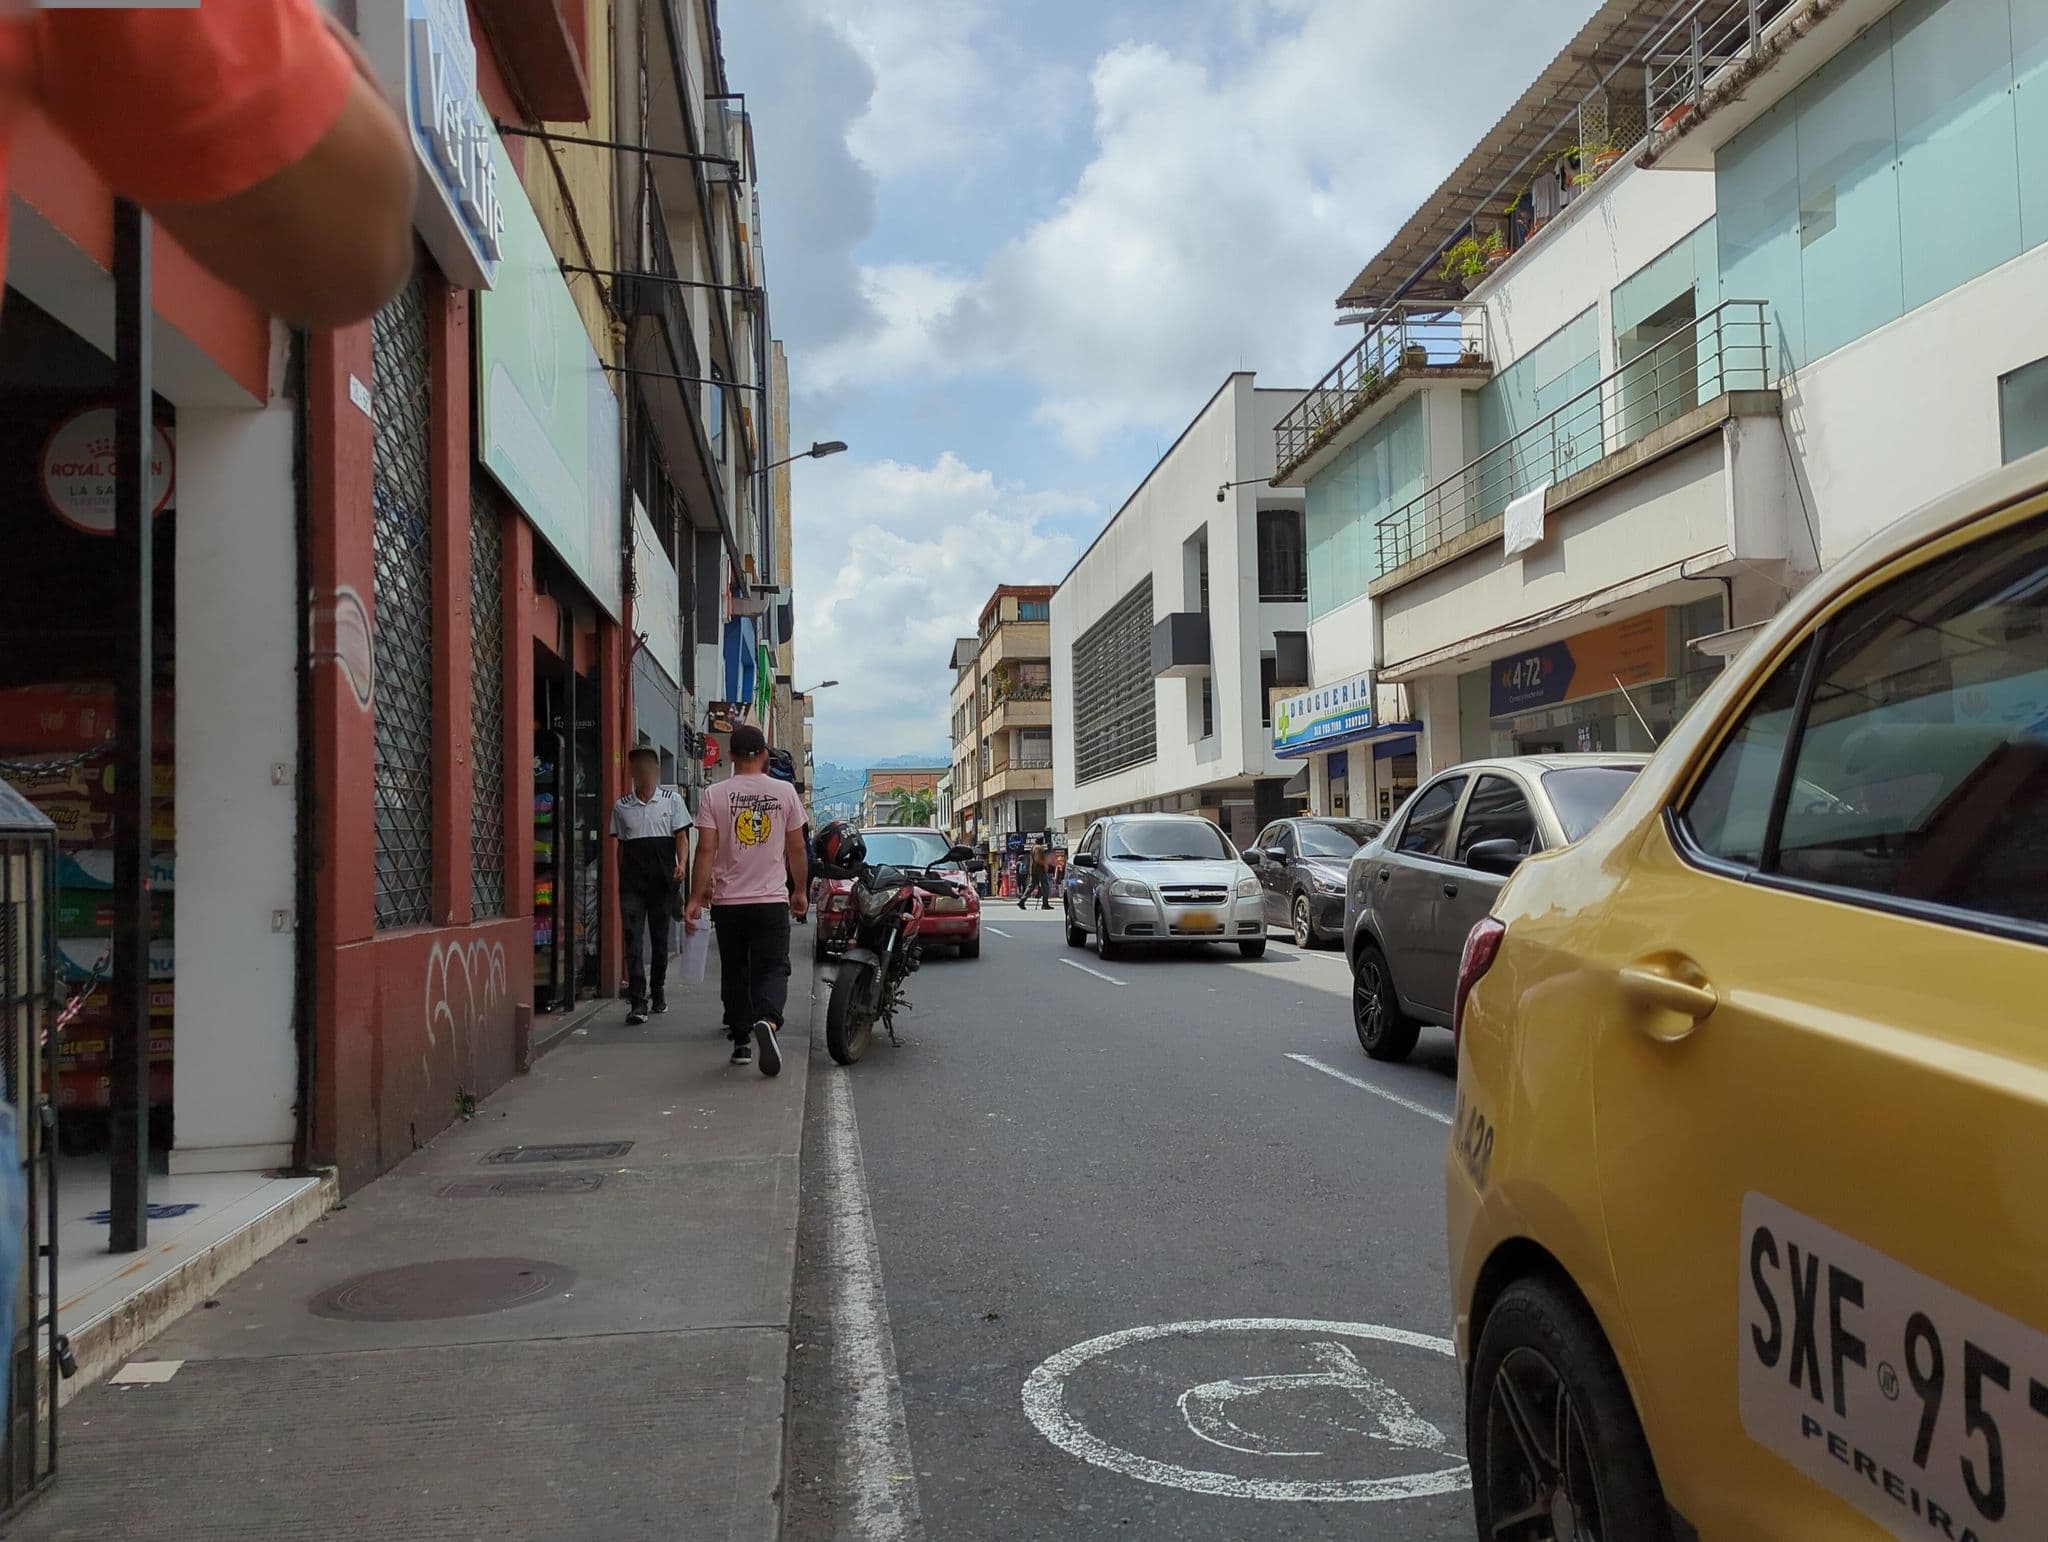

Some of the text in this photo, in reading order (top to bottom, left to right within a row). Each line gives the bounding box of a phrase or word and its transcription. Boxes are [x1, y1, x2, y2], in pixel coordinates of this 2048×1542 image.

[470, 120, 505, 262] Life
[51, 462, 104, 477] ROYAL
[70, 486, 88, 497] LA
[1290, 677, 1367, 718] DROGUERÍA
[729, 791, 760, 806] Happy
[1750, 1226, 1867, 1418] SXF
